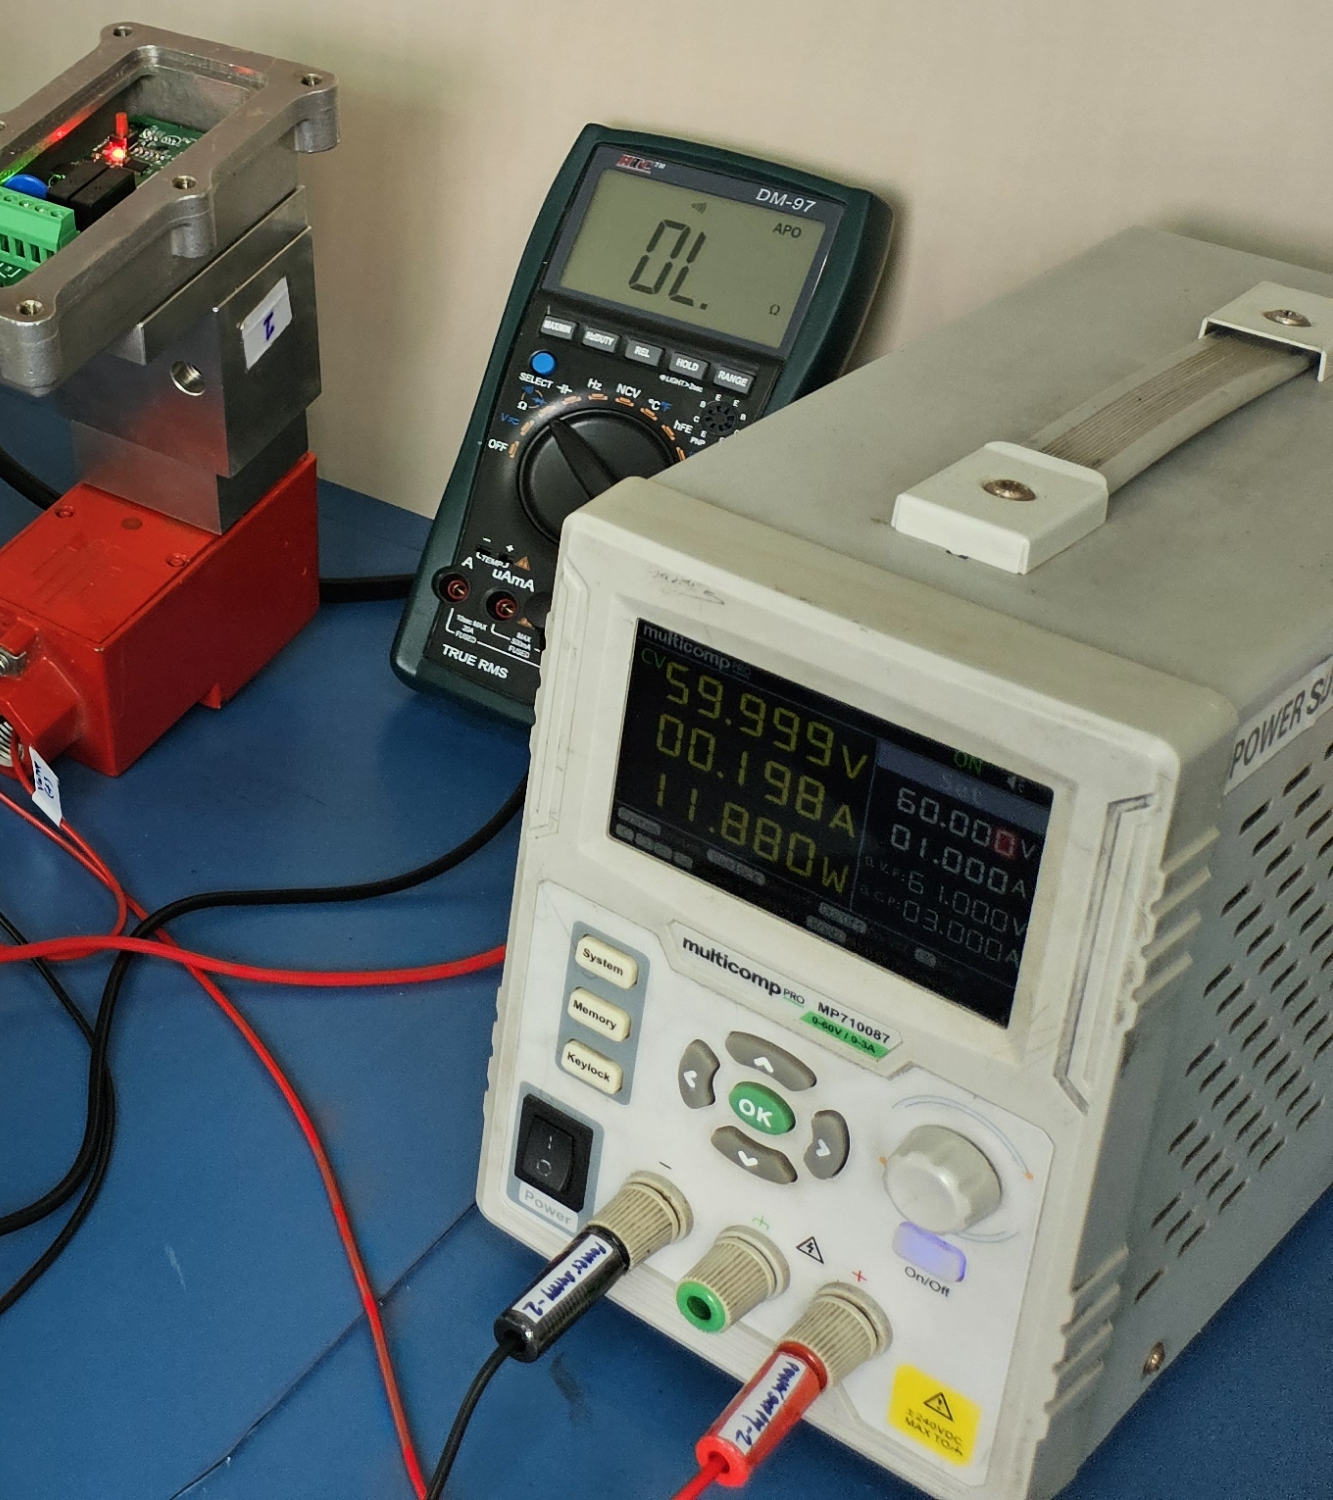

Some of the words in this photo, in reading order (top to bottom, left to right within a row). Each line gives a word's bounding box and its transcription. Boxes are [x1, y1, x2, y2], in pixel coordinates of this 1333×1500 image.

[755, 188, 817, 214] DM-97
[772, 223, 802, 239] APO
[634, 346, 650, 358] REL
[675, 358, 700, 372] HOLD
[519, 372, 554, 389] SELECT
[587, 378, 603, 391] Hz
[616, 382, 641, 399] NCV
[717, 370, 748, 387] RANGE
[673, 420, 693, 434] hFE
[488, 438, 509, 452] OFF
[461, 556, 474, 570] A
[492, 568, 535, 593] uAmA
[641, 647, 667, 669] CV
[643, 625, 731, 671] multicomp
[443, 643, 478, 667] TRUE
[478, 658, 509, 680] RMS
[1229, 690, 1306, 780] POWER
[954, 750, 983, 775] ON
[582, 947, 624, 977] System
[683, 936, 781, 996] multicomp
[782, 987, 805, 1005] PRO
[817, 1001, 890, 1044] MP710087
[572, 998, 618, 1031] Memory
[812, 1016, 842, 1036] 0-60V
[851, 1036, 876, 1053] 0-3A
[566, 1050, 611, 1083] Keylock
[738, 1098, 773, 1128] OK
[524, 1189, 572, 1225] Power
[904, 1266, 950, 1299] On/Off
[905, 1416, 931, 1438] MAX
